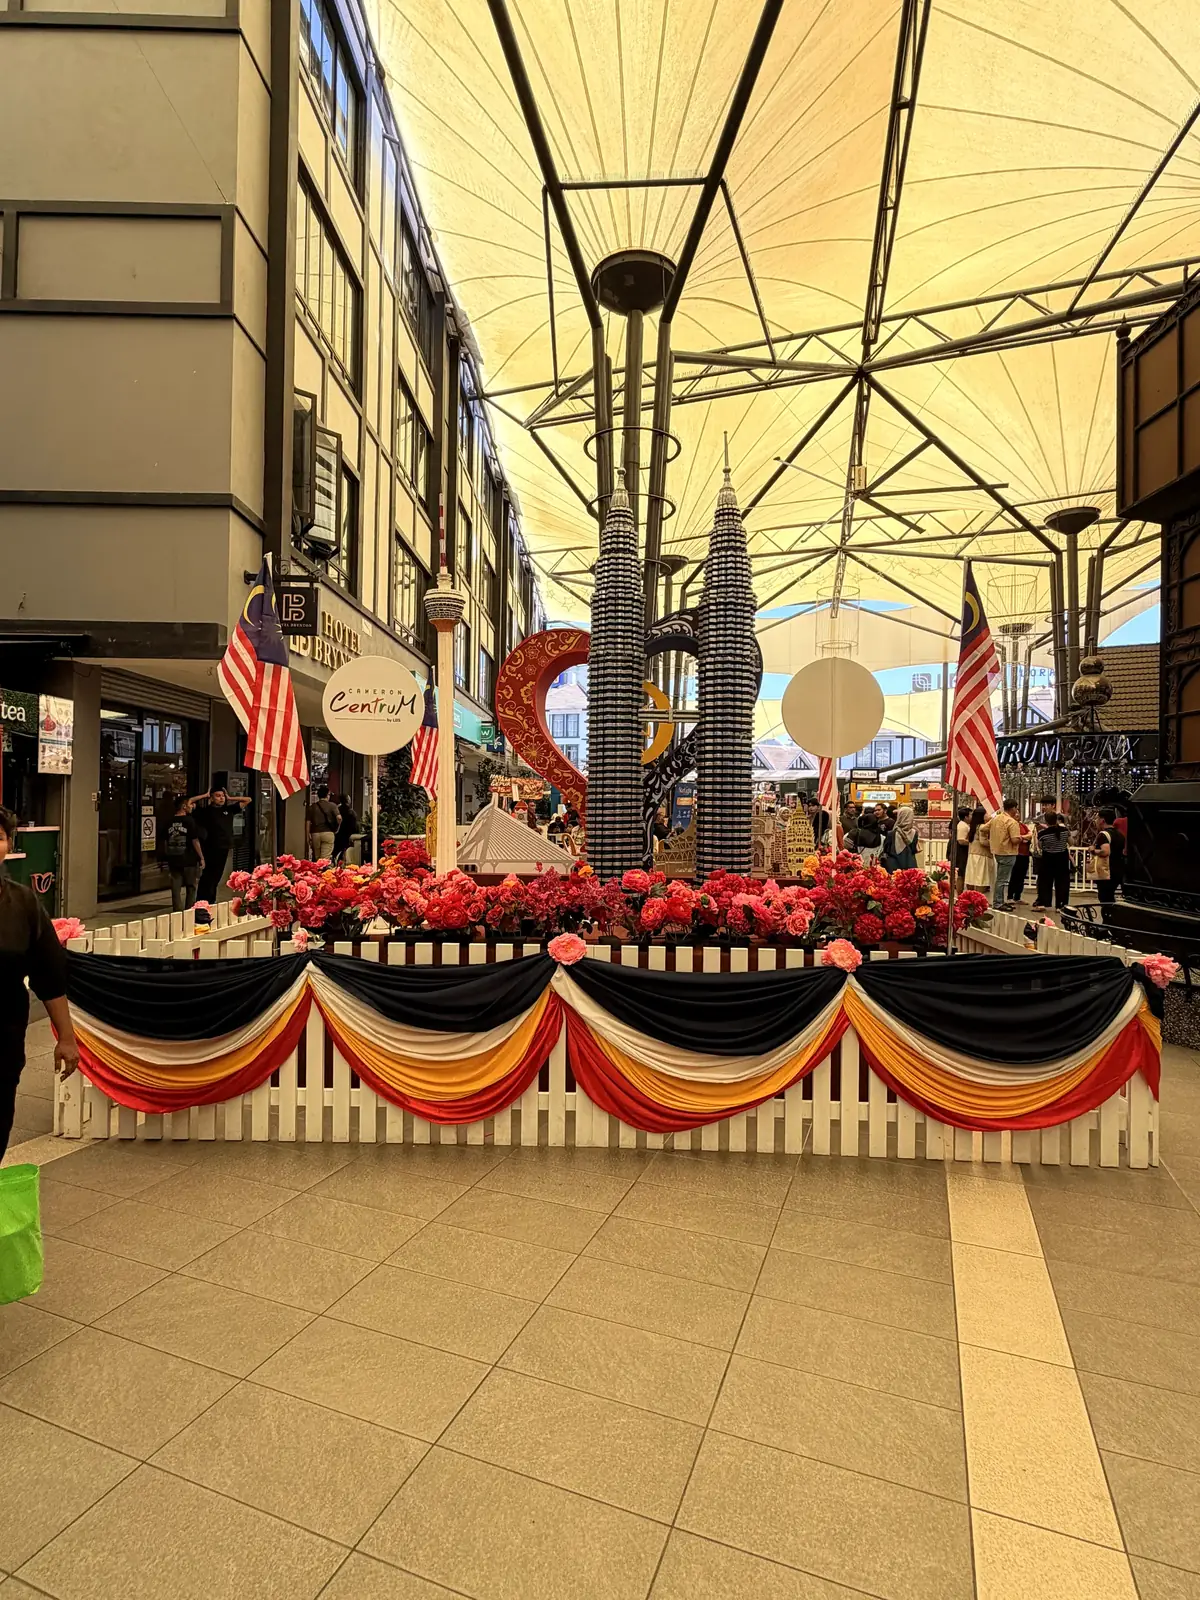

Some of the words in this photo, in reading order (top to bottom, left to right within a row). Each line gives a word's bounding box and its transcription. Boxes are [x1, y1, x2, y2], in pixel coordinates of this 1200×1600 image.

[322, 610, 363, 656] HOTEL
[312, 636, 355, 670] BRYN
[0, 701, 26, 722] tea
